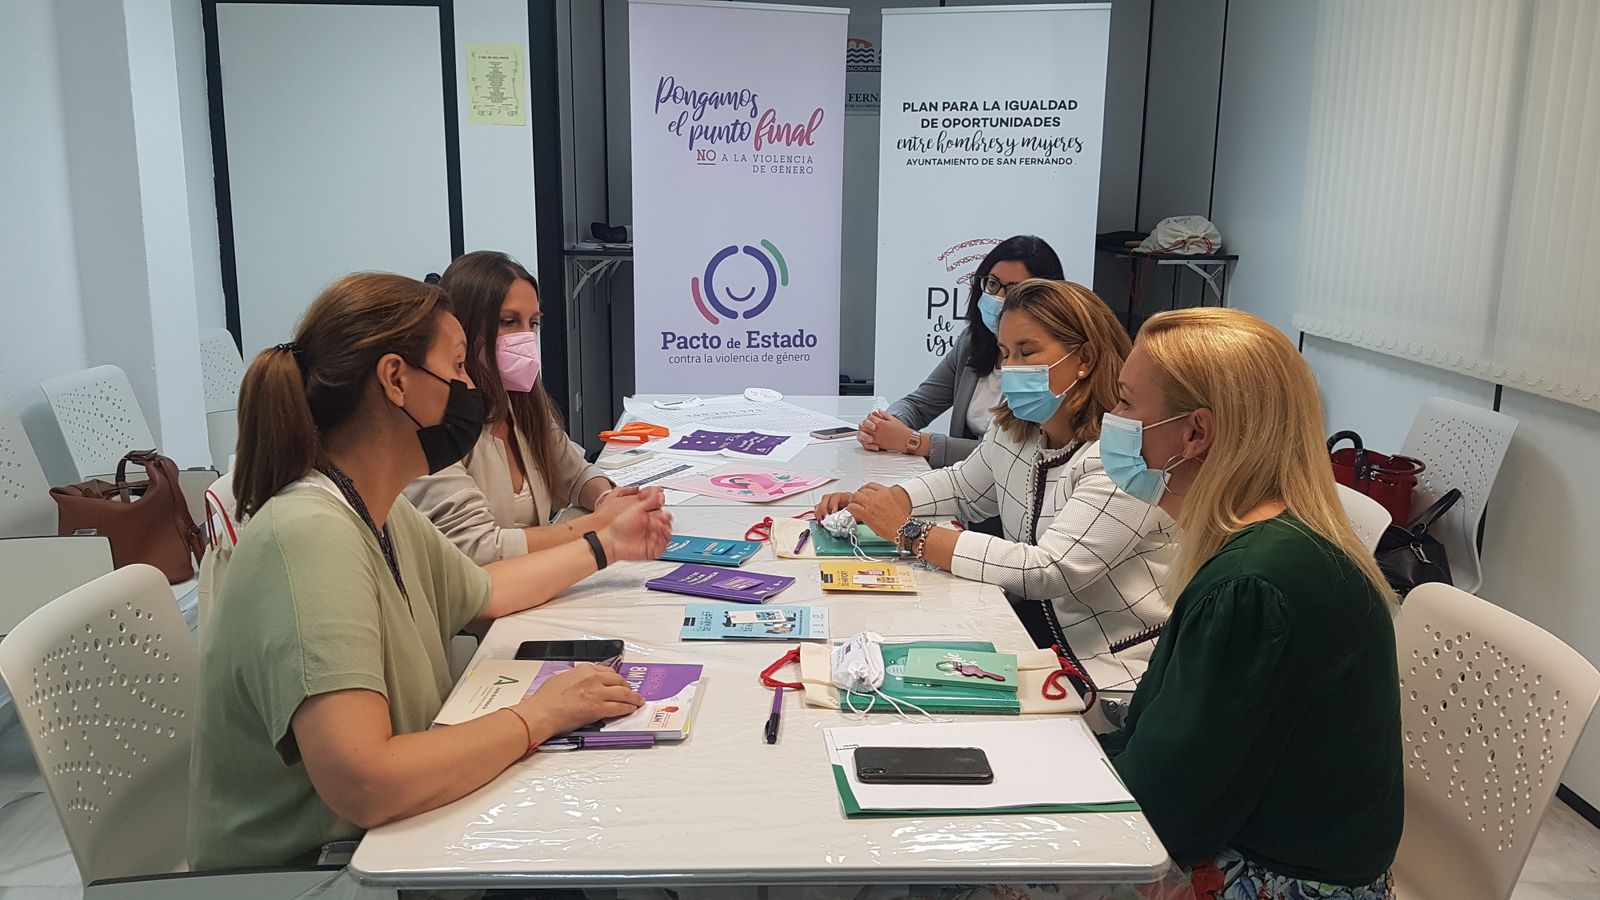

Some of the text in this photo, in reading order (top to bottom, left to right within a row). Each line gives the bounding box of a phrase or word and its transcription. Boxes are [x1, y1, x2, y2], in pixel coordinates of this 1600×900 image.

[655, 76, 759, 121] Pongamos
[902, 100, 1078, 112] PLAN PARA LA IGUALDAD
[668, 108, 825, 151] el punto final
[921, 117, 1061, 128] DE OPORTUNIDADES
[897, 130, 1084, 157] entre hombres y mujeres
[696, 149, 814, 164] NO A LA VIOLENCIA
[906, 158, 979, 166] AYUNTAMIENTO
[1018, 157, 1073, 165] FERNANDO
[752, 163, 814, 174] DE GÉNERO
[927, 287, 969, 320] PL
[934, 315, 954, 332] de
[661, 329, 817, 350] Pacto de Estado
[668, 351, 810, 365] contra la violencia de género
